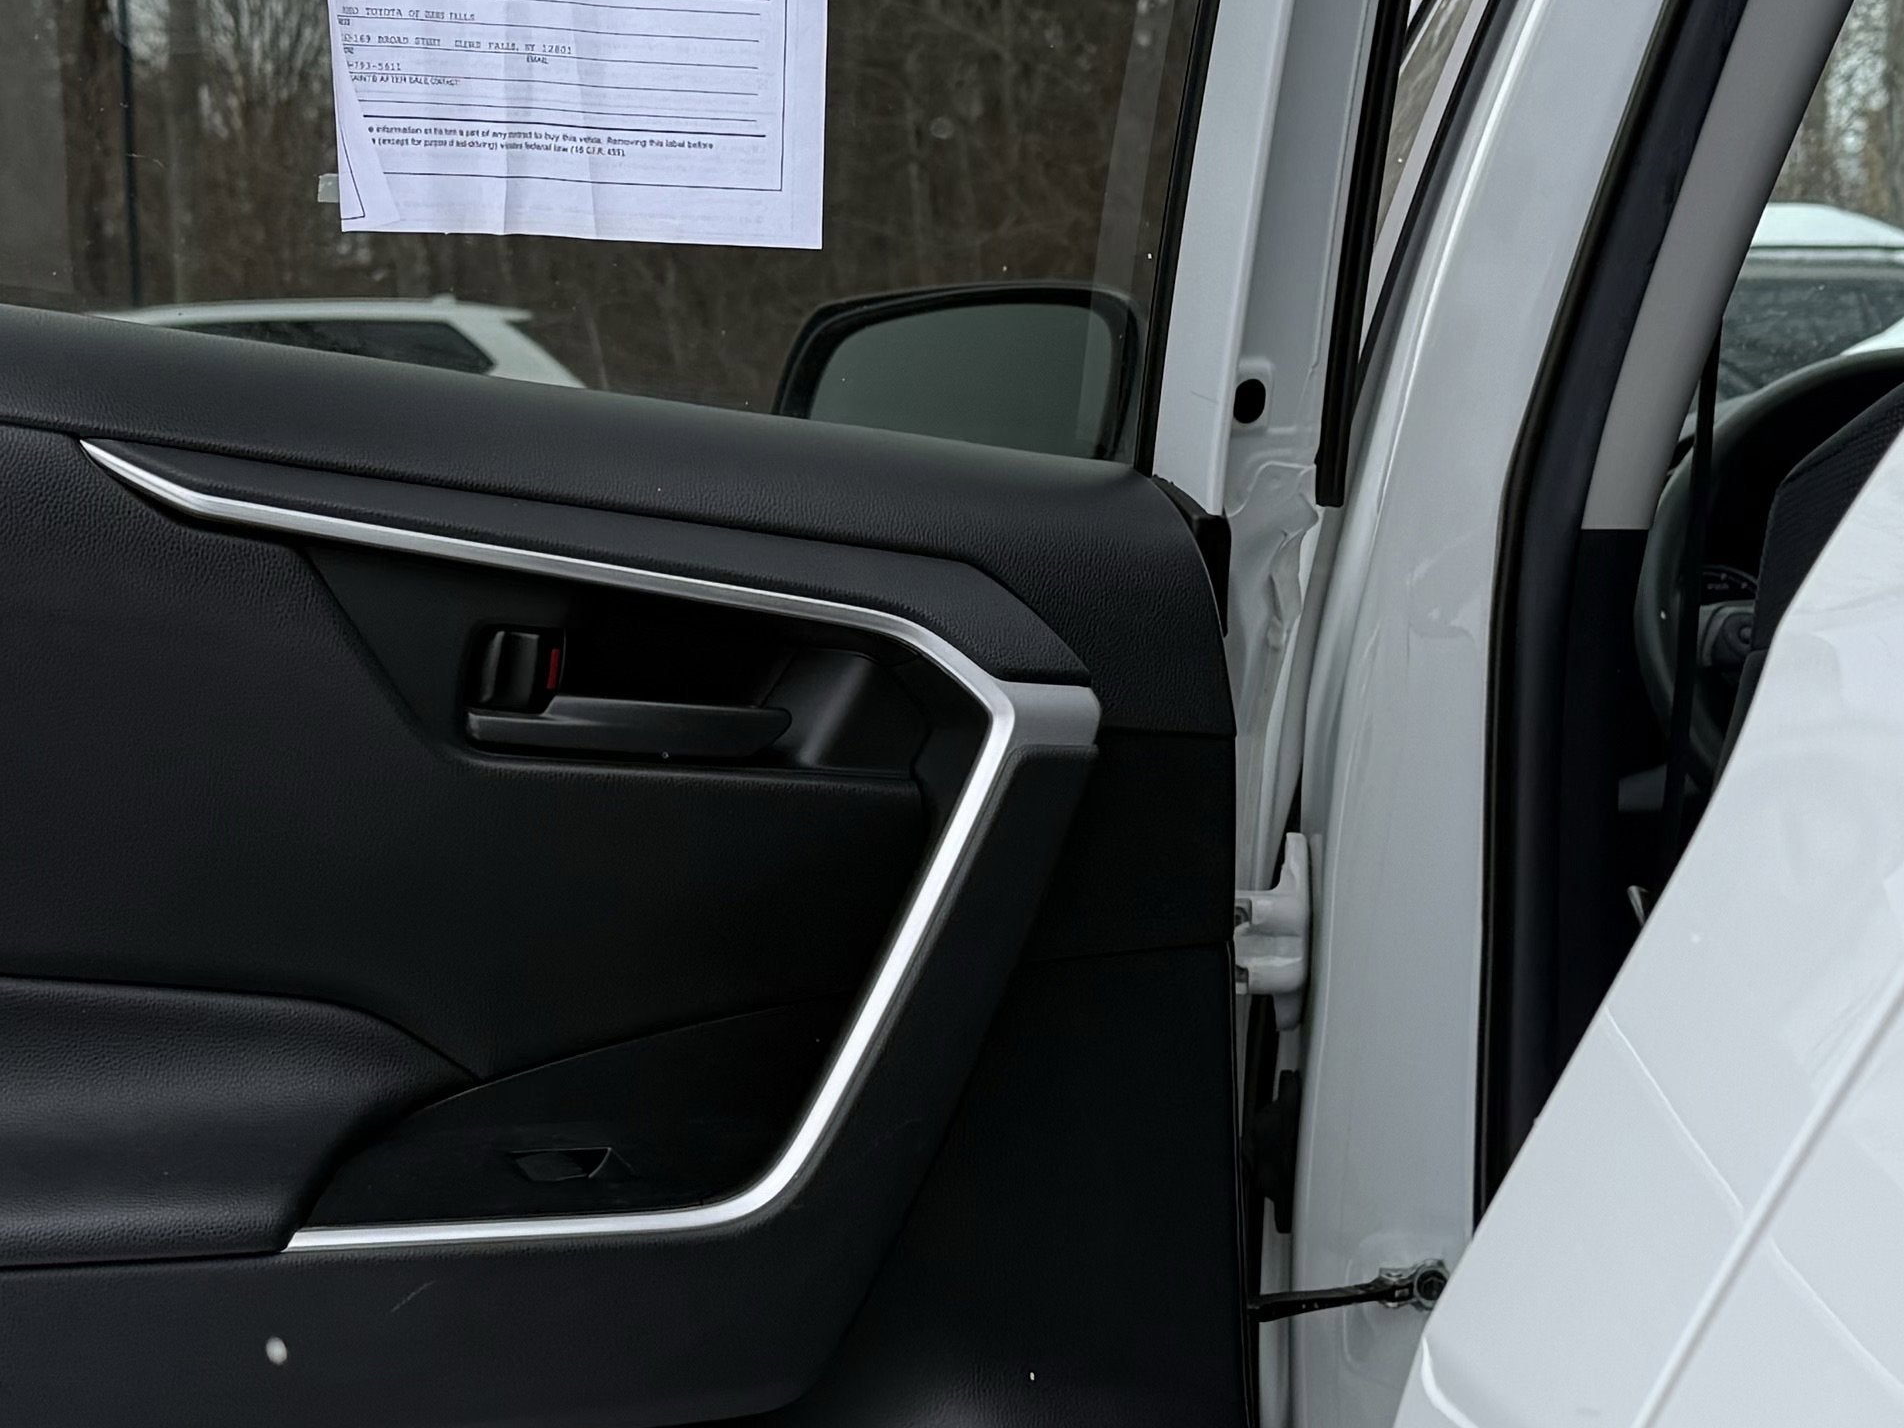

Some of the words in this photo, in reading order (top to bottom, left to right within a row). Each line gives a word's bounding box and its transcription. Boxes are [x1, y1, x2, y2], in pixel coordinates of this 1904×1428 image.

[365, 7, 403, 18] TOYOTA
[542, 44, 572, 54] 12801
[544, 132, 560, 142] buy
[607, 136, 647, 147] Removing
[649, 139, 664, 147] this
[665, 139, 685, 148] label
[687, 141, 714, 150] before
